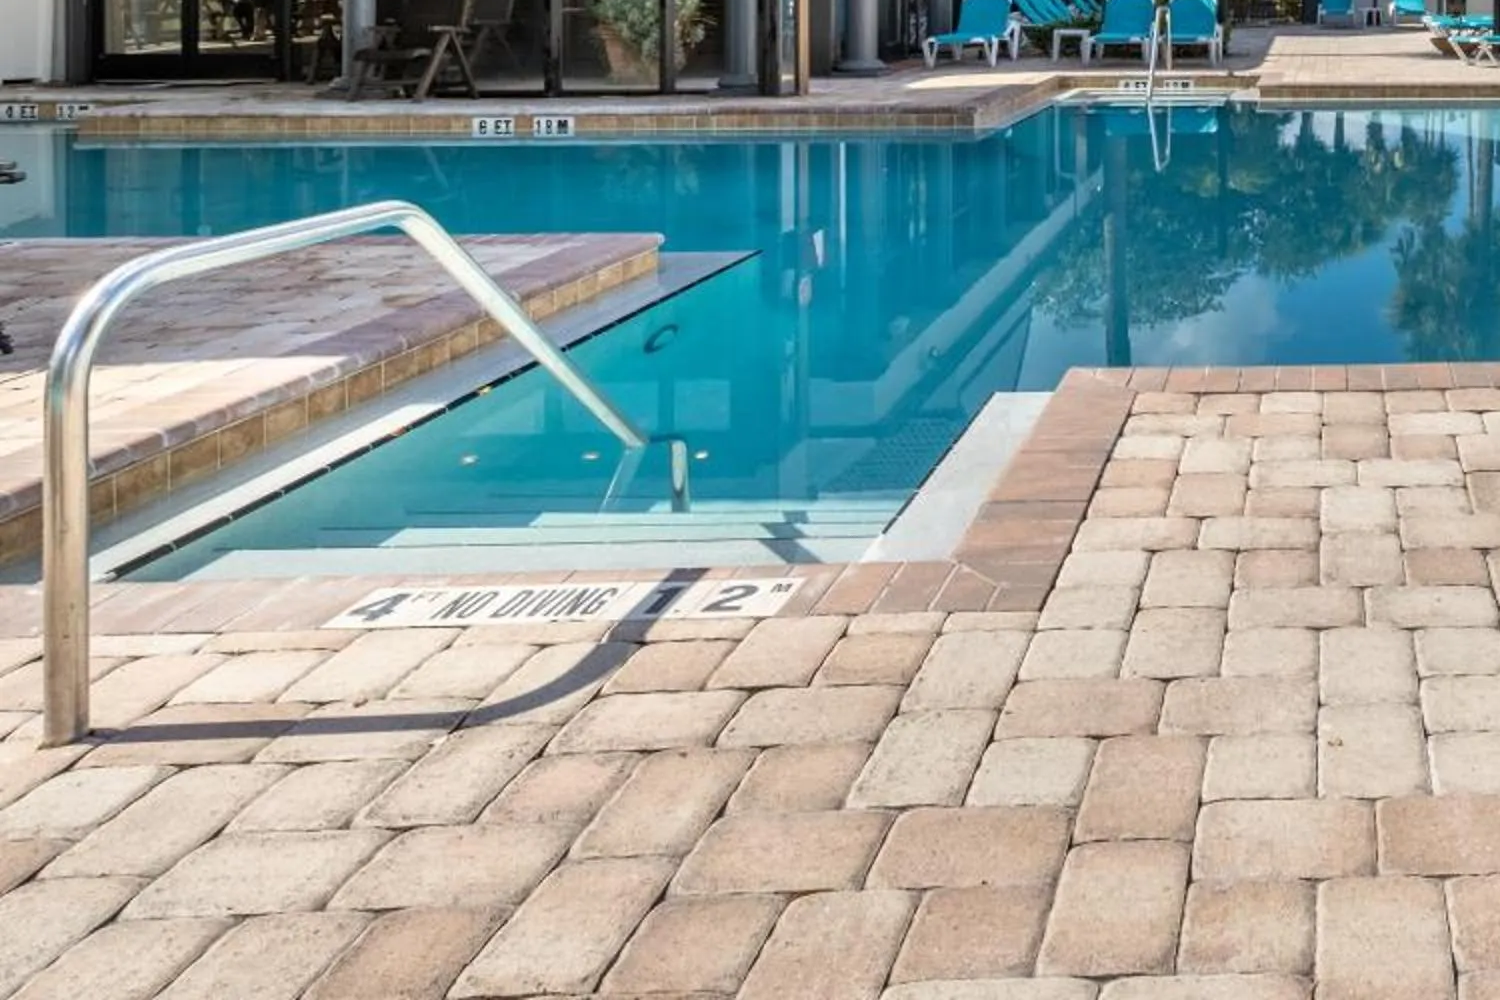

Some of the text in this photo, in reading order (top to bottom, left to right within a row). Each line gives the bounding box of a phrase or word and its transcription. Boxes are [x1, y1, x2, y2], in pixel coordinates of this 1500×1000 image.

[346, 592, 412, 622] 4
[428, 590, 500, 620] NO
[489, 586, 618, 619] DIVING
[769, 582, 793, 594] M
